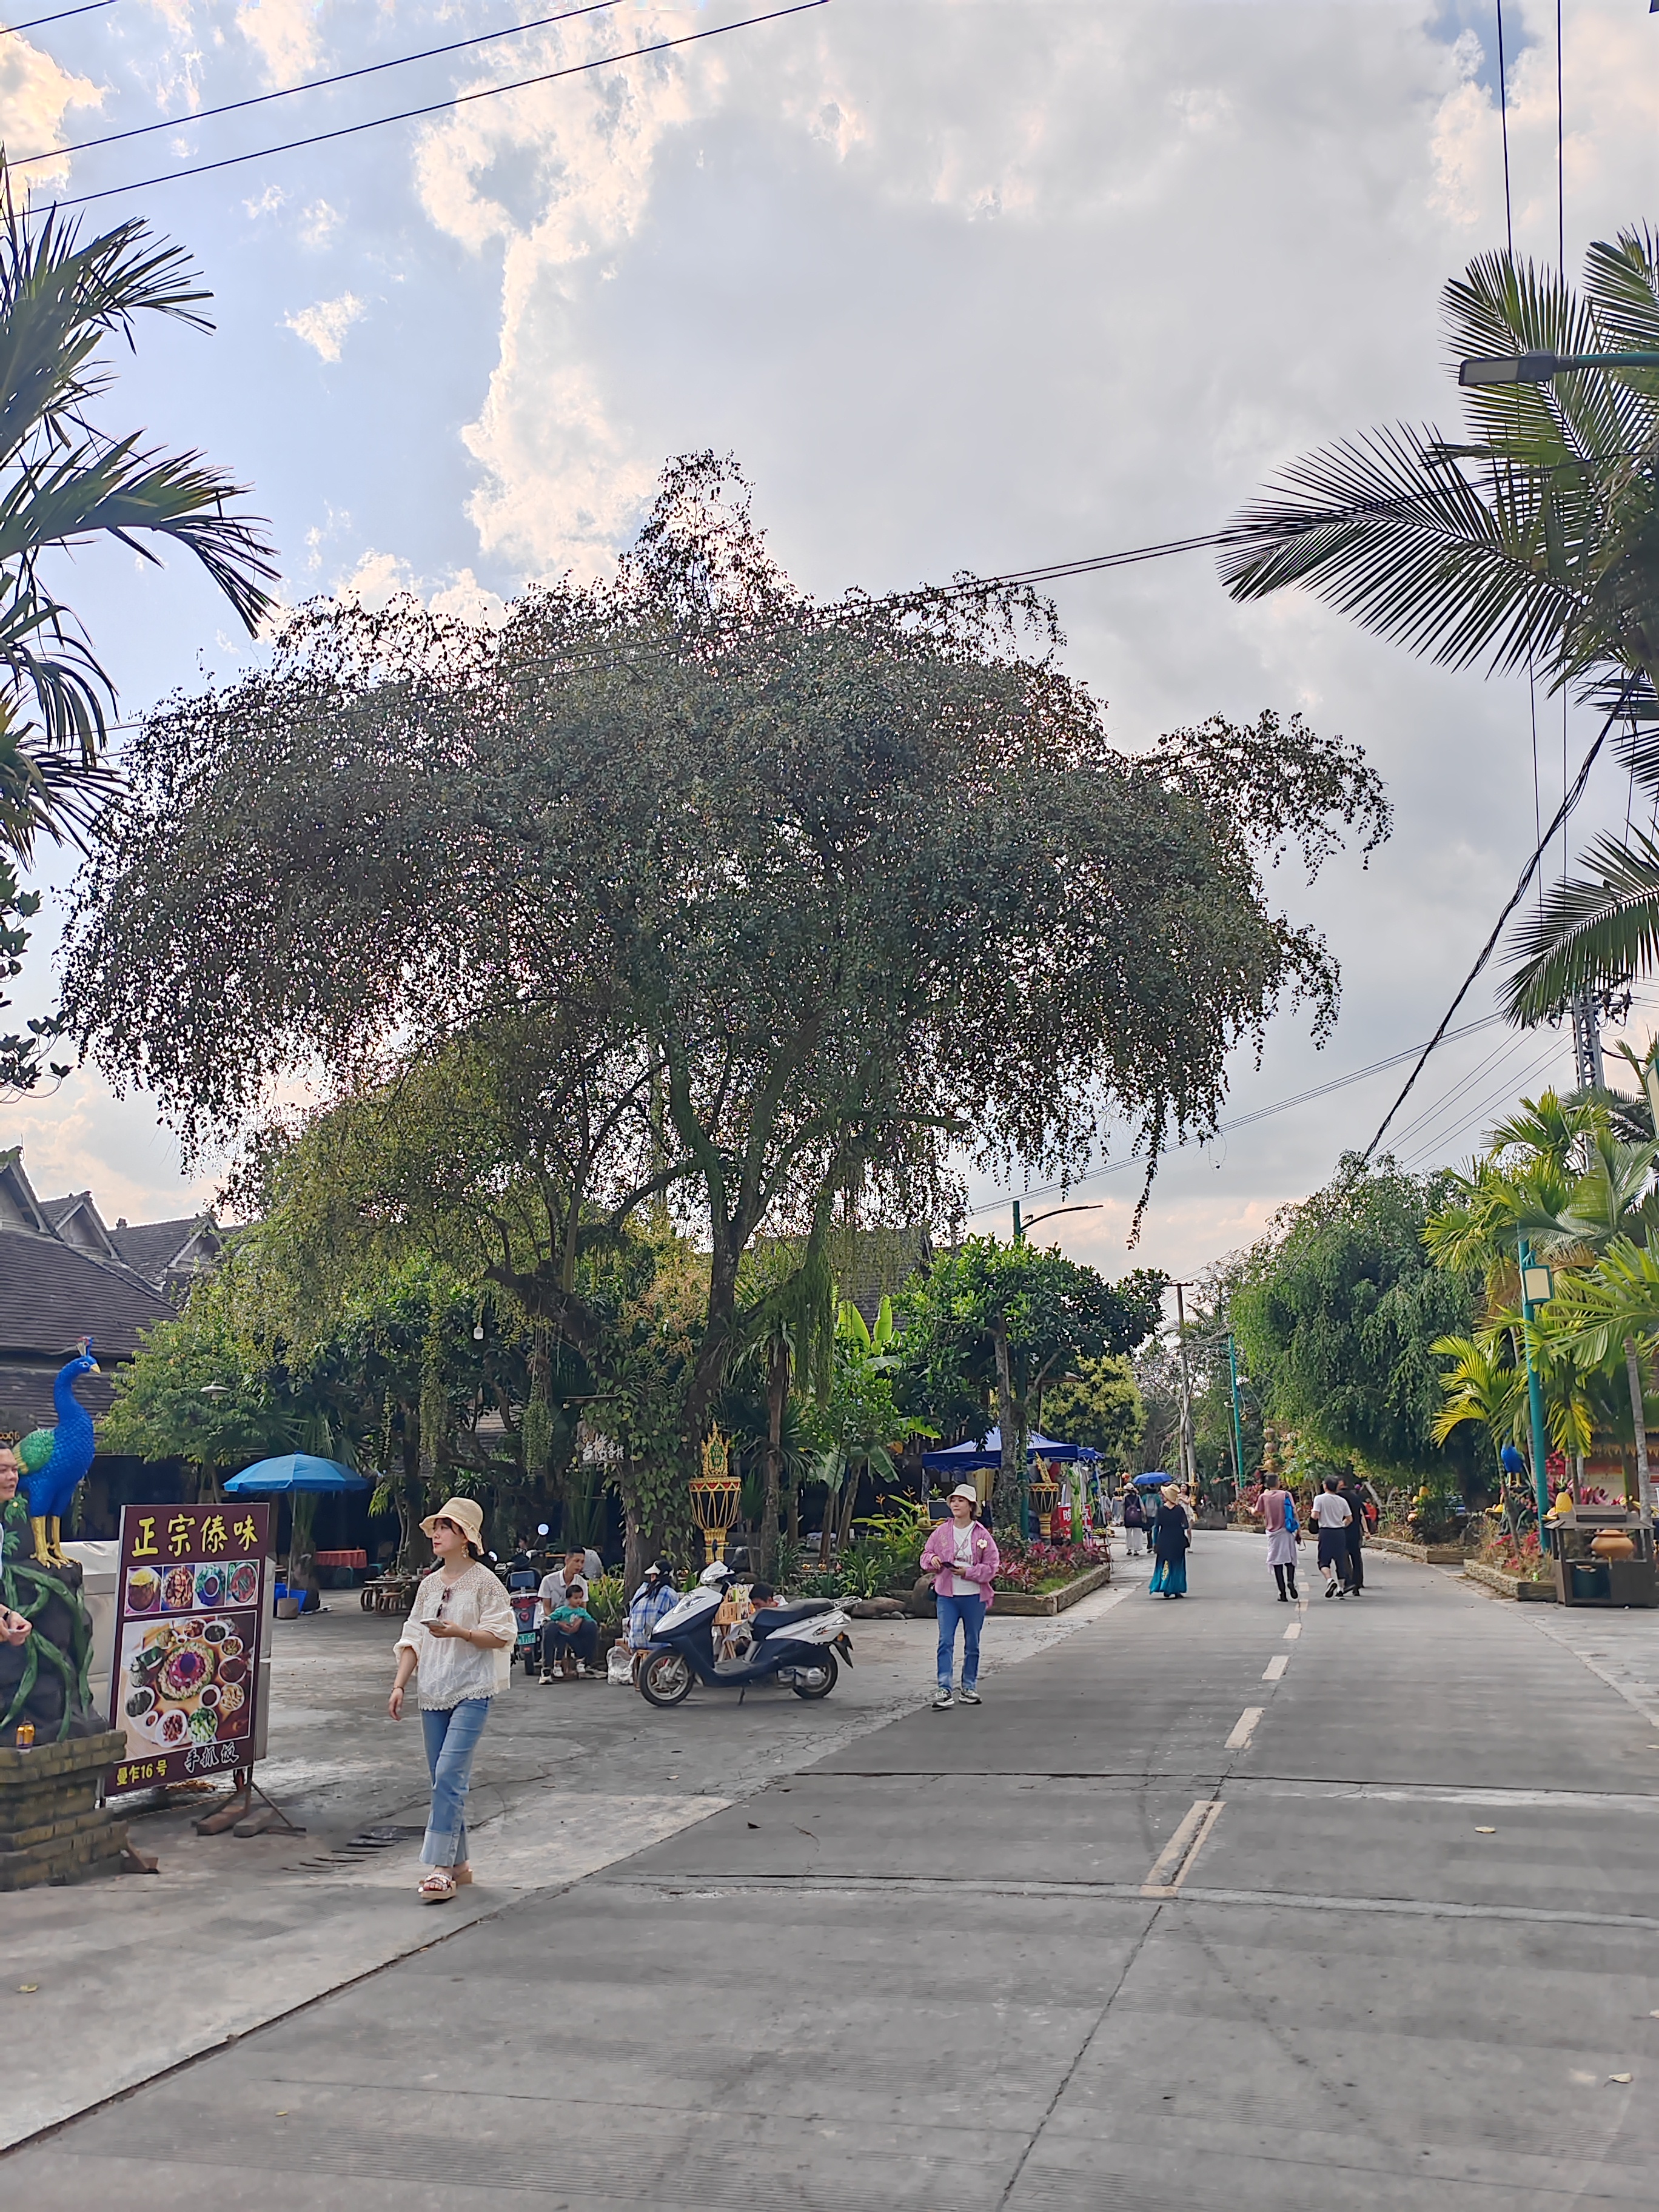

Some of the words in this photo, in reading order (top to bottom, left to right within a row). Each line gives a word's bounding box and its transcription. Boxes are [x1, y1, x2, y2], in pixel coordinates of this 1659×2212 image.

[131, 1513, 258, 1558] 正宗傣味
[184, 1741, 240, 1774] 手抓饭
